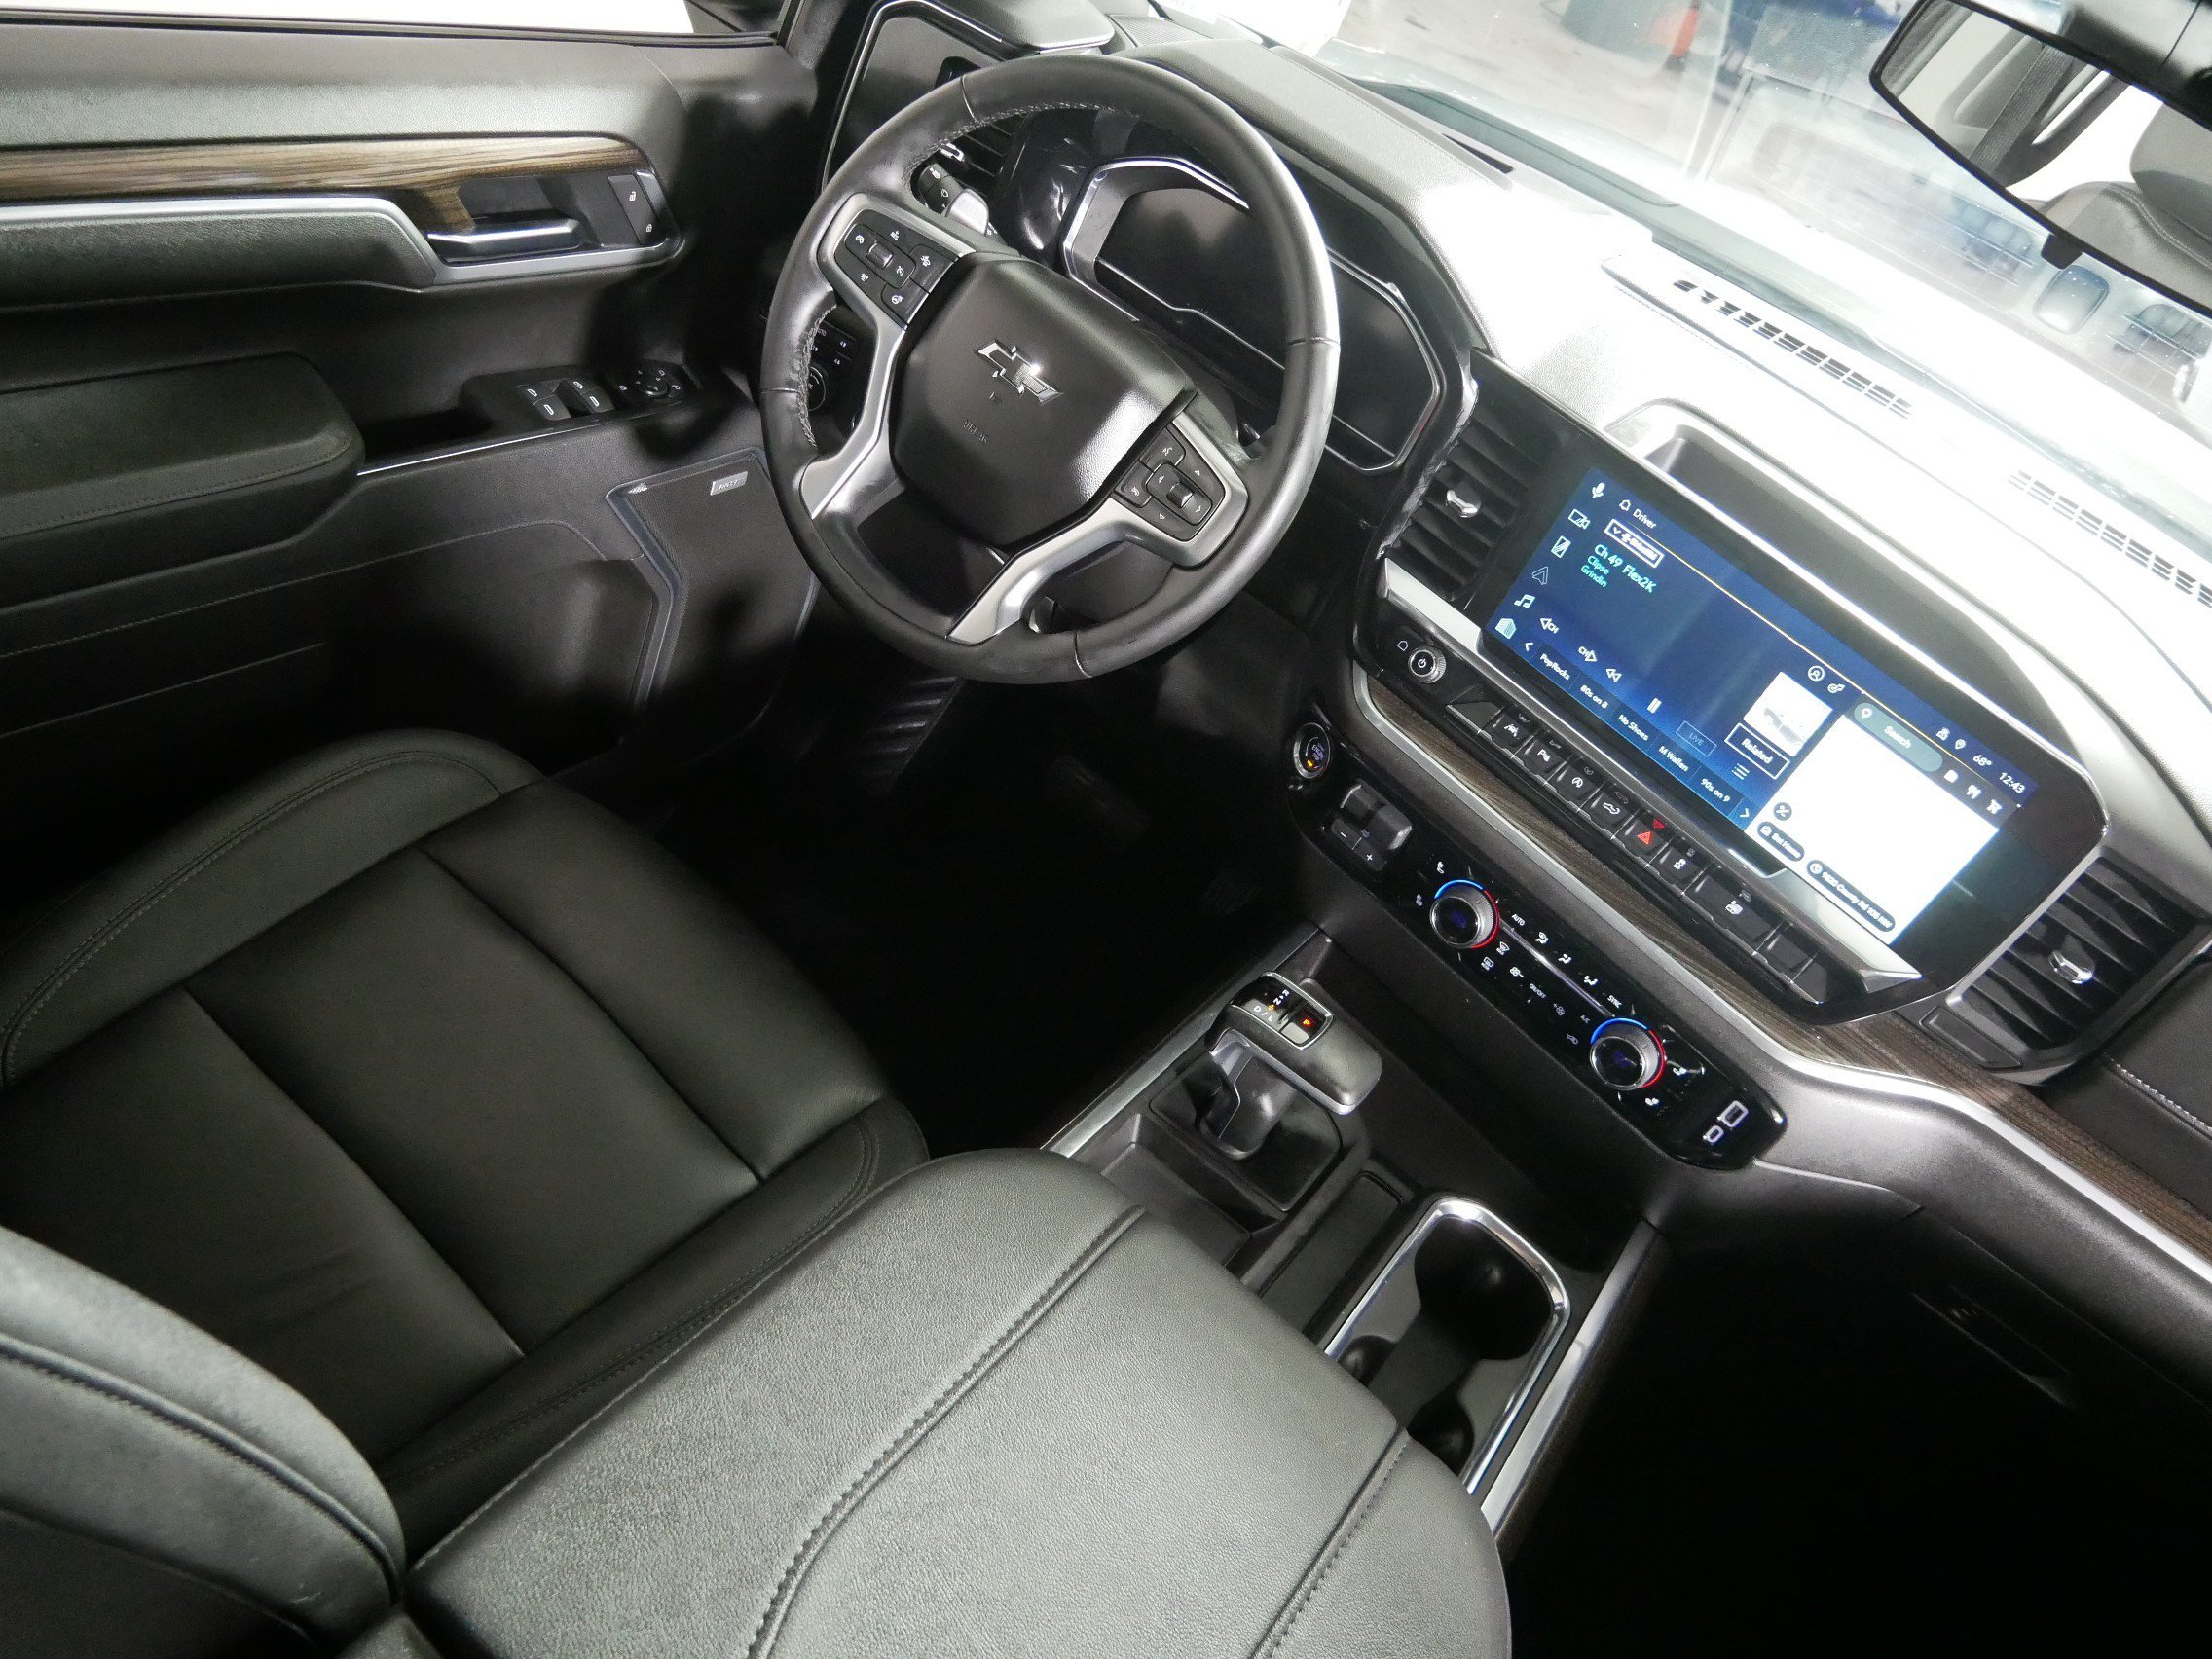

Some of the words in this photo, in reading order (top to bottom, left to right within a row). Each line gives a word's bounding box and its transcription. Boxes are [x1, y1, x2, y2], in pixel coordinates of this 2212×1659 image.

[1632, 508, 1657, 529] Driver
[1587, 555, 1610, 575] Clipse
[1594, 543, 1609, 560] Ch
[1607, 554, 1624, 568] 49
[1621, 564, 1657, 593] Flex2K
[1580, 565, 1608, 588] Grindin
[1579, 684, 1594, 698] 80s
[1592, 695, 1603, 705] on
[1617, 714, 1630, 725] No
[1627, 721, 1649, 741] Shoes
[1884, 725, 1911, 749] Search
[1688, 732, 1705, 747] LIVE
[1658, 745, 1669, 756] M
[1666, 751, 1689, 772] Wallen
[1741, 737, 1774, 764] Related
[1700, 778, 1714, 792] 90s
[1713, 790, 1724, 799] on
[1999, 772, 2025, 793] 12:43
[1511, 913, 1526, 926] AUTO
[1606, 994, 1623, 1009] SYNC
